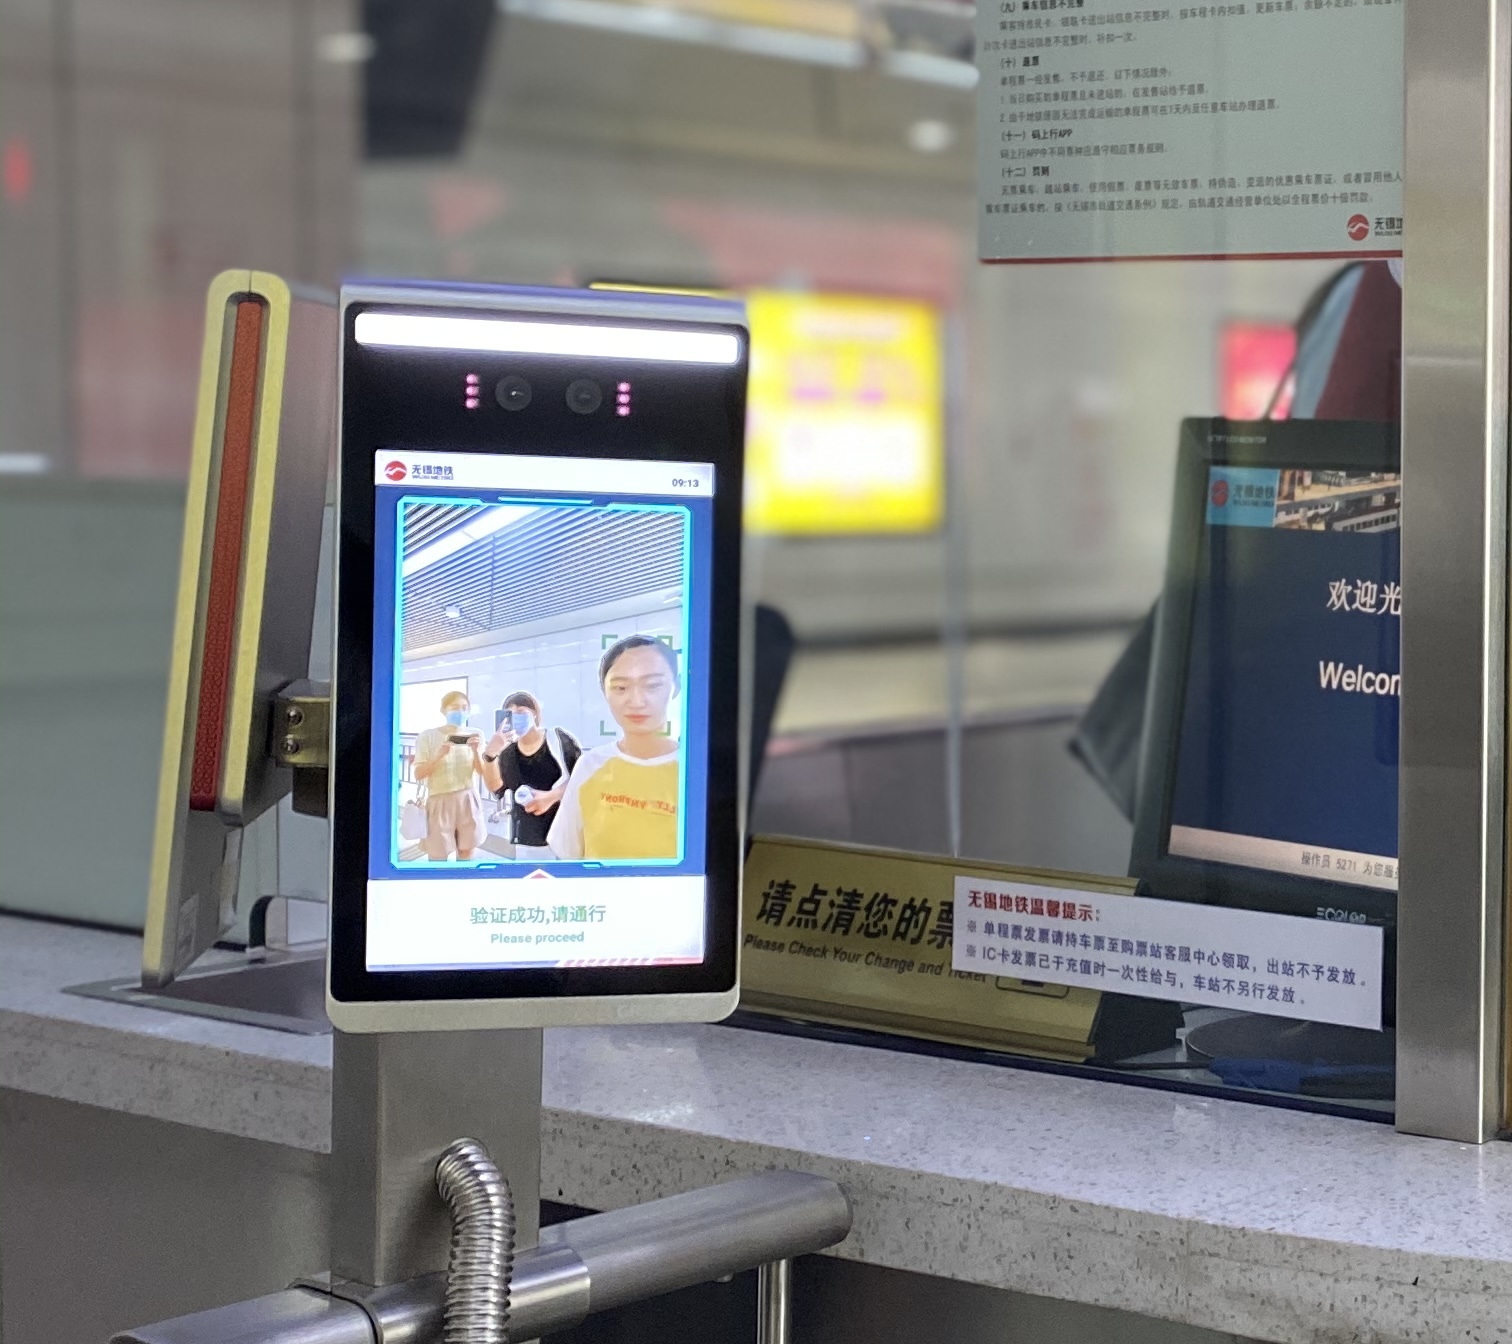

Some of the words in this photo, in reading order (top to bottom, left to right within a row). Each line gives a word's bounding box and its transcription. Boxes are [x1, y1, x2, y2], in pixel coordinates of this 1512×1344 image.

[412, 464, 453, 476] 无锡地铁
[672, 478, 700, 488] 09:13
[1301, 851, 1331, 869] 操作员
[1336, 858, 1357, 872] 5271
[469, 903, 607, 926] 验证成功,请通行
[756, 879, 953, 950] 请点清您的票
[490, 930, 531, 945] Please
[535, 930, 585, 947] proceed
[743, 933, 786, 954] Please
[788, 940, 829, 960] Check
[832, 947, 863, 965] Your
[864, 951, 915, 975] Change
[917, 961, 945, 977] and
